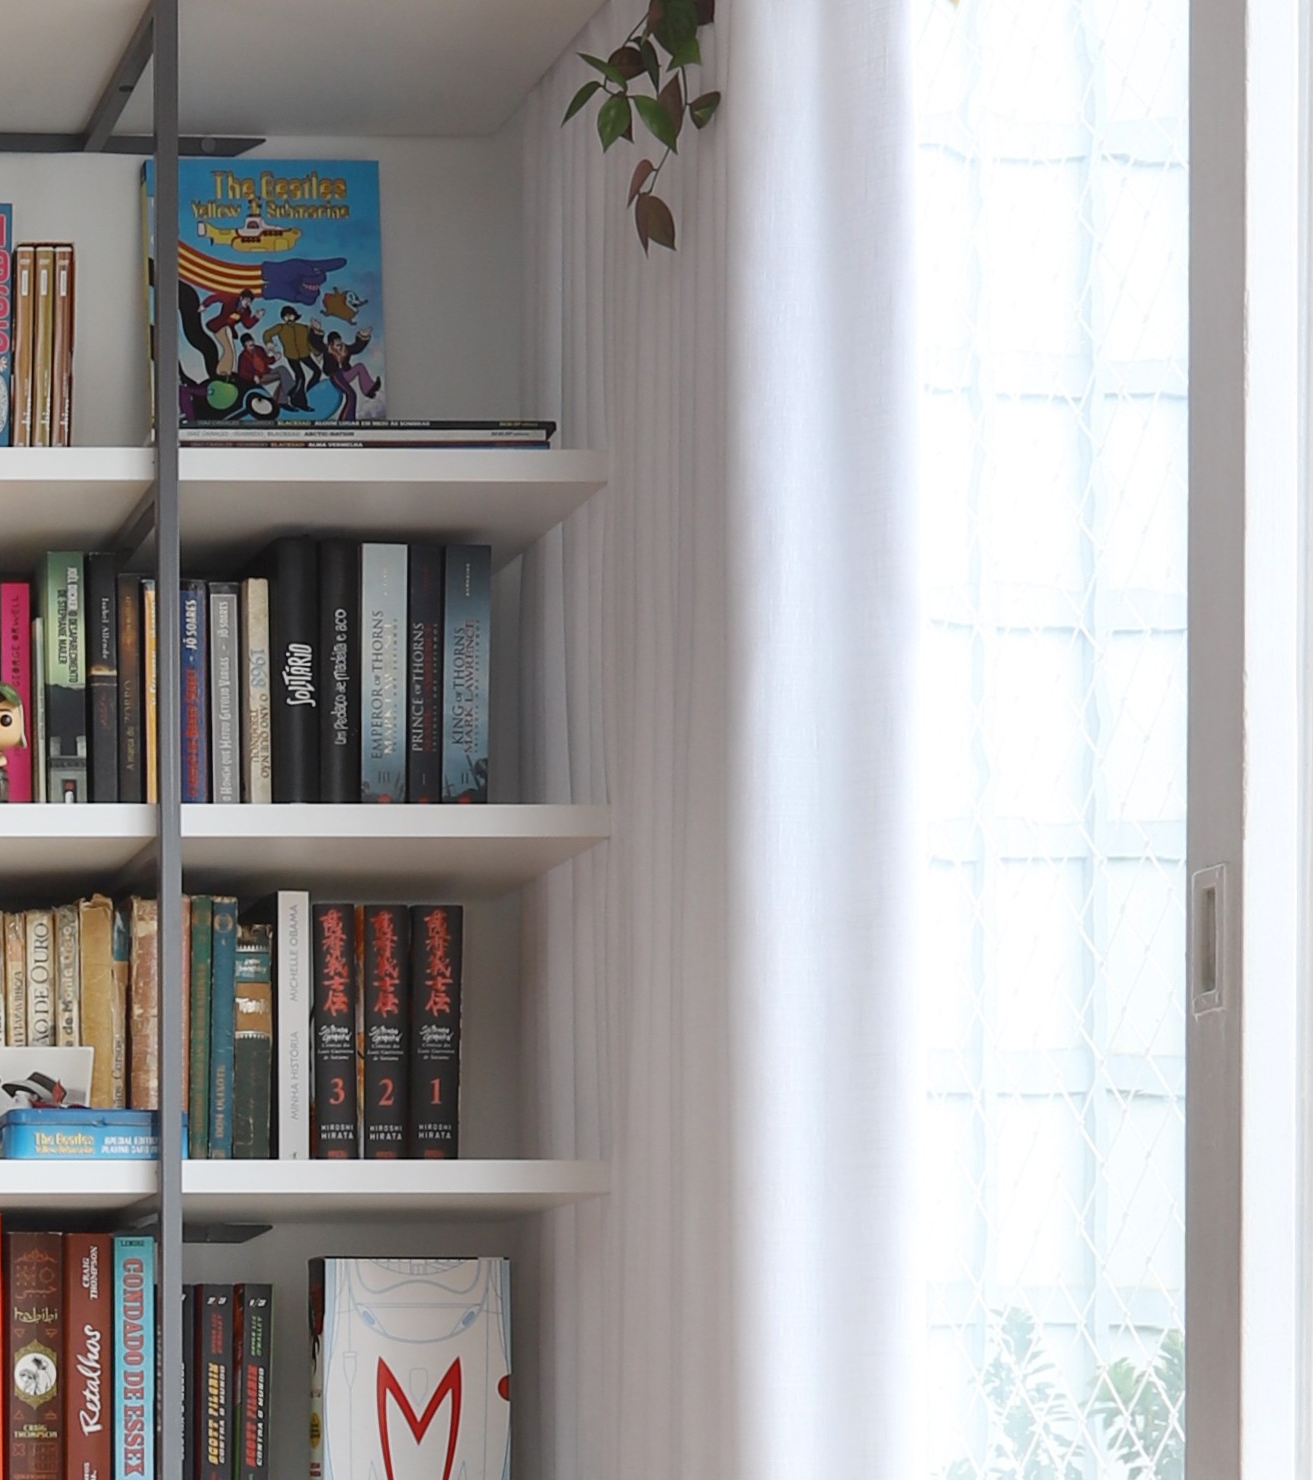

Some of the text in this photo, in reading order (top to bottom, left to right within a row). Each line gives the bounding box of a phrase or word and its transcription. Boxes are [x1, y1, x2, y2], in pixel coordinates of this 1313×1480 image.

[210, 170, 348, 200] The Beatles
[412, 623, 424, 683] THORNS
[412, 698, 424, 751] PRINCE
[329, 1078, 345, 1105] 3
[378, 1080, 394, 1106] 2
[430, 1078, 442, 1105] 1
[321, 1131, 354, 1140] HIRATA
[76, 1324, 102, 1436] Retalhos
[122, 1258, 144, 1476] CONDADO DE ESSEX
